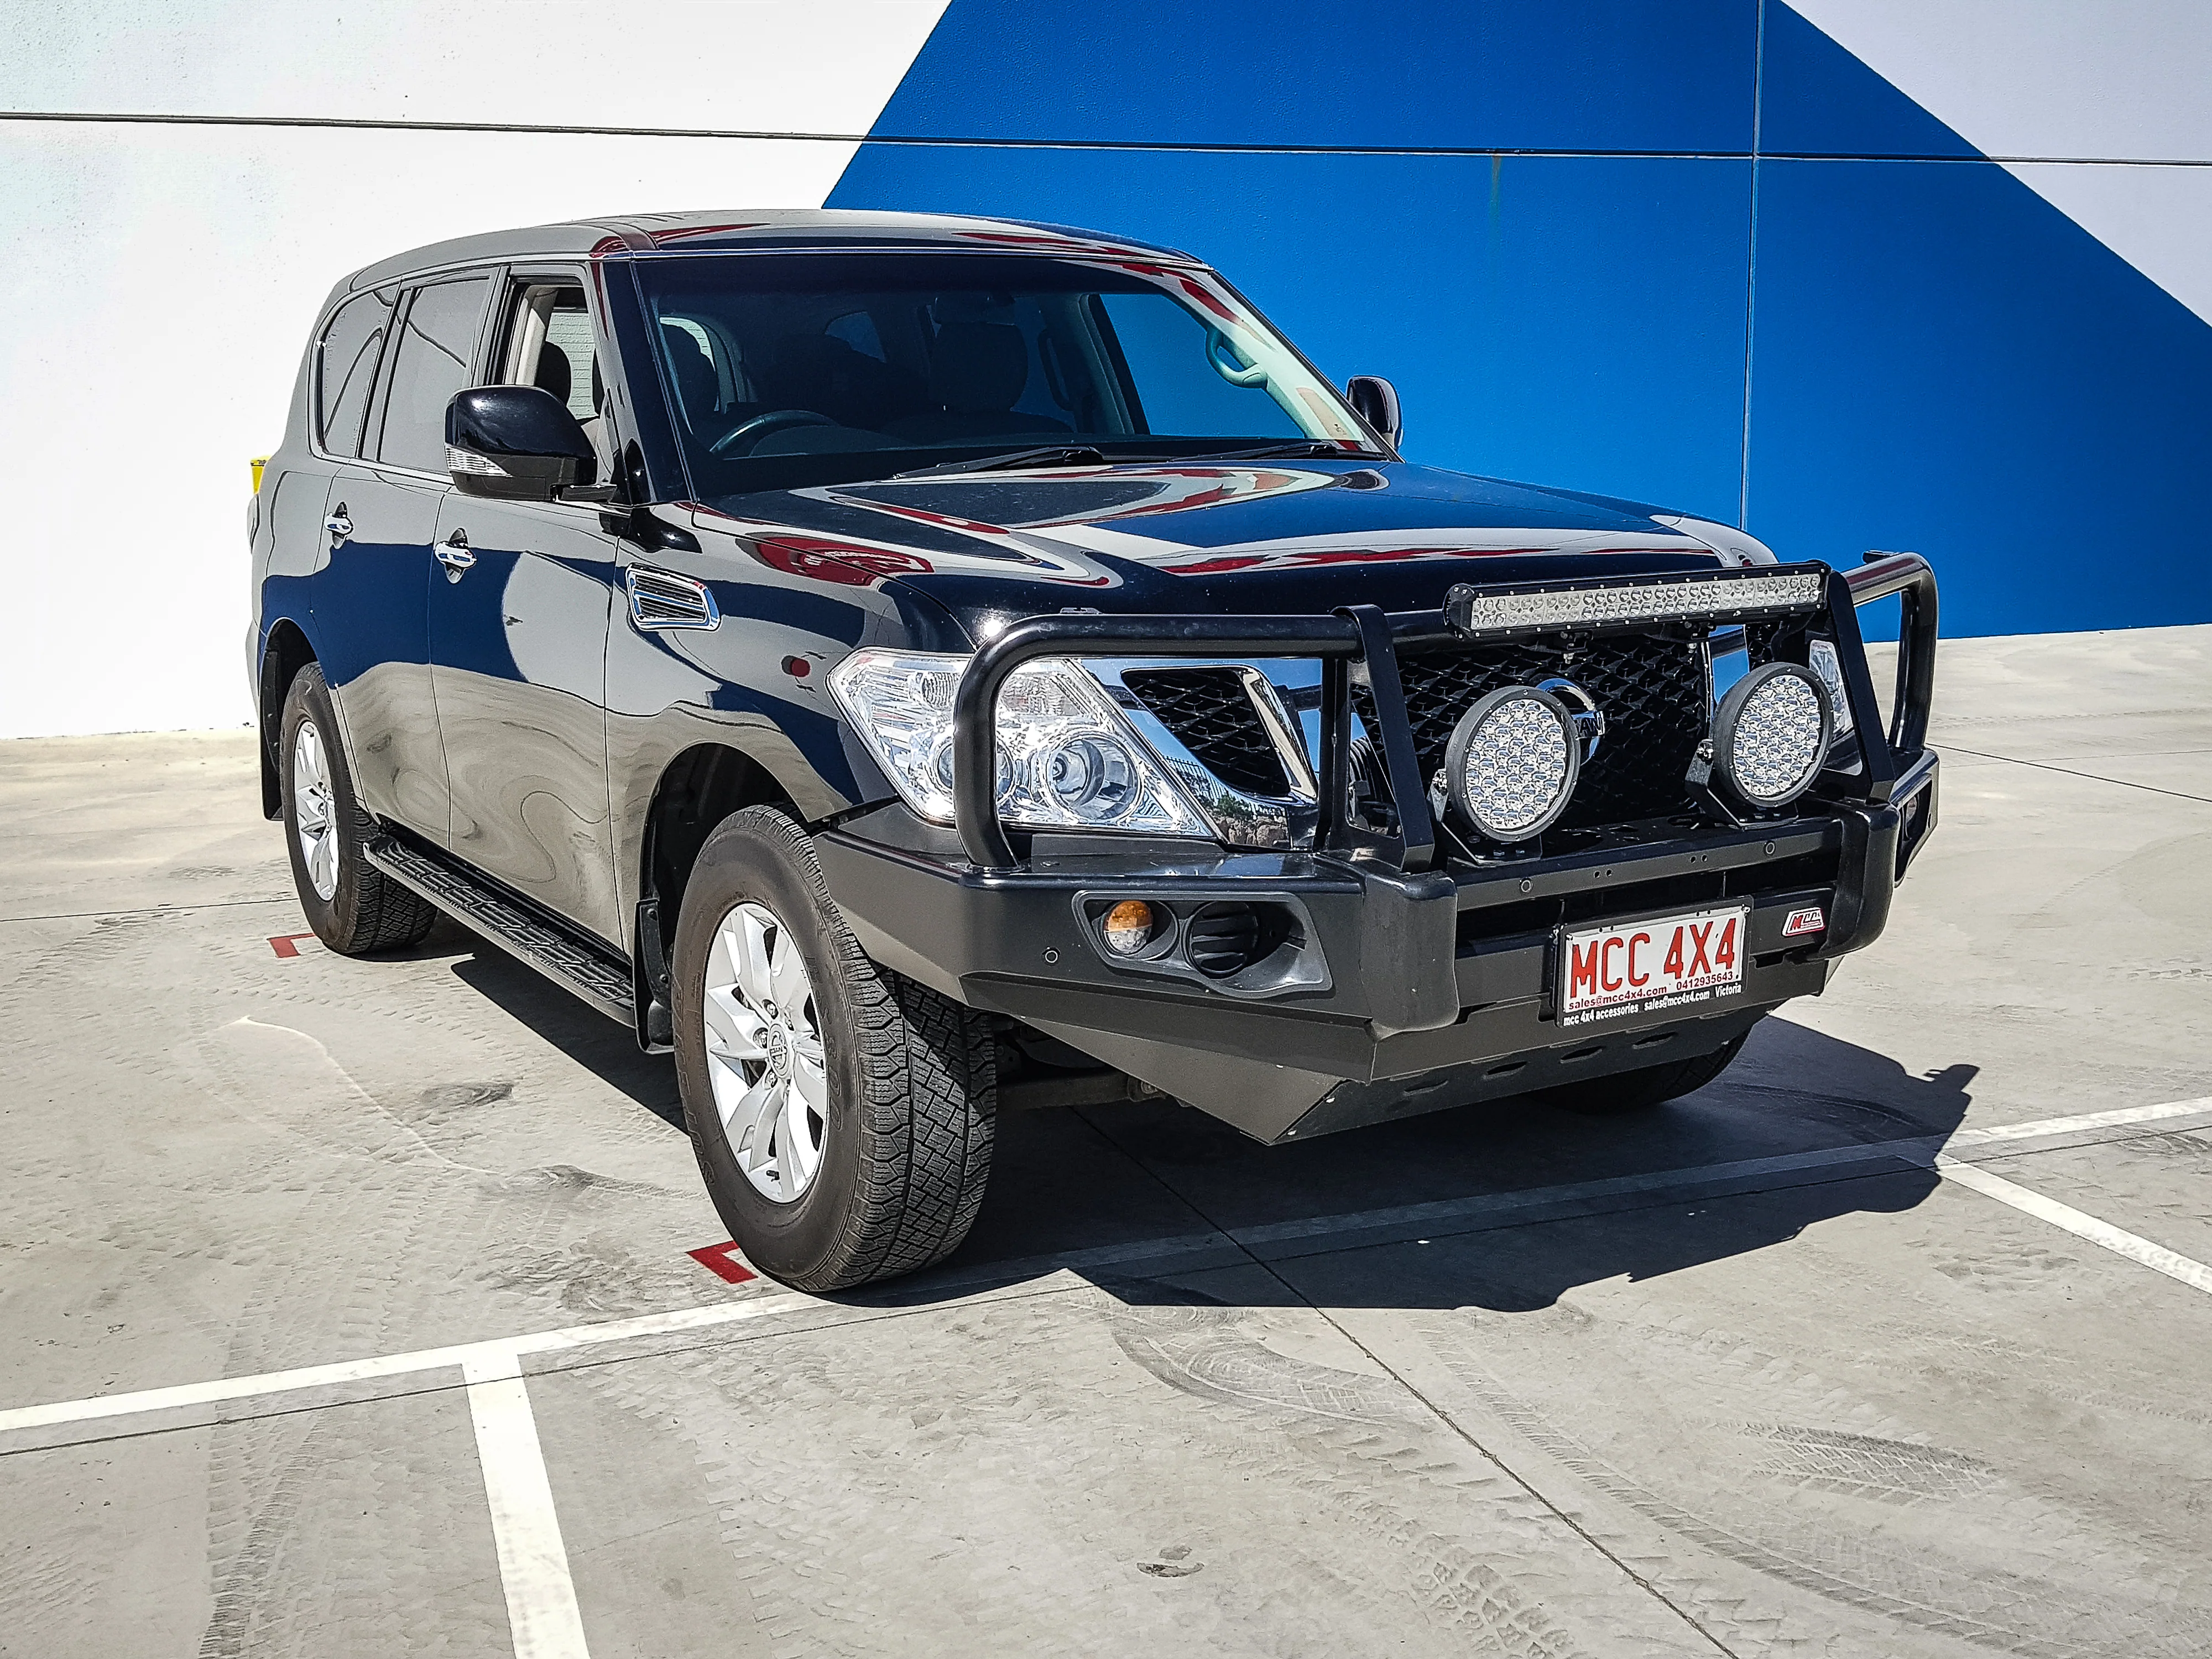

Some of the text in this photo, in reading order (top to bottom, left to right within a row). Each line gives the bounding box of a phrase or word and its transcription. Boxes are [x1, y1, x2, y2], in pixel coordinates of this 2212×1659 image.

[1570, 918, 1736, 998] MCC 4X4
[1563, 983, 1741, 1026] mcc 4x4 accessories sales@mcc4x4.com Victoria
[1569, 971, 1733, 1010] sales@mcc4x4.com 0412935643
